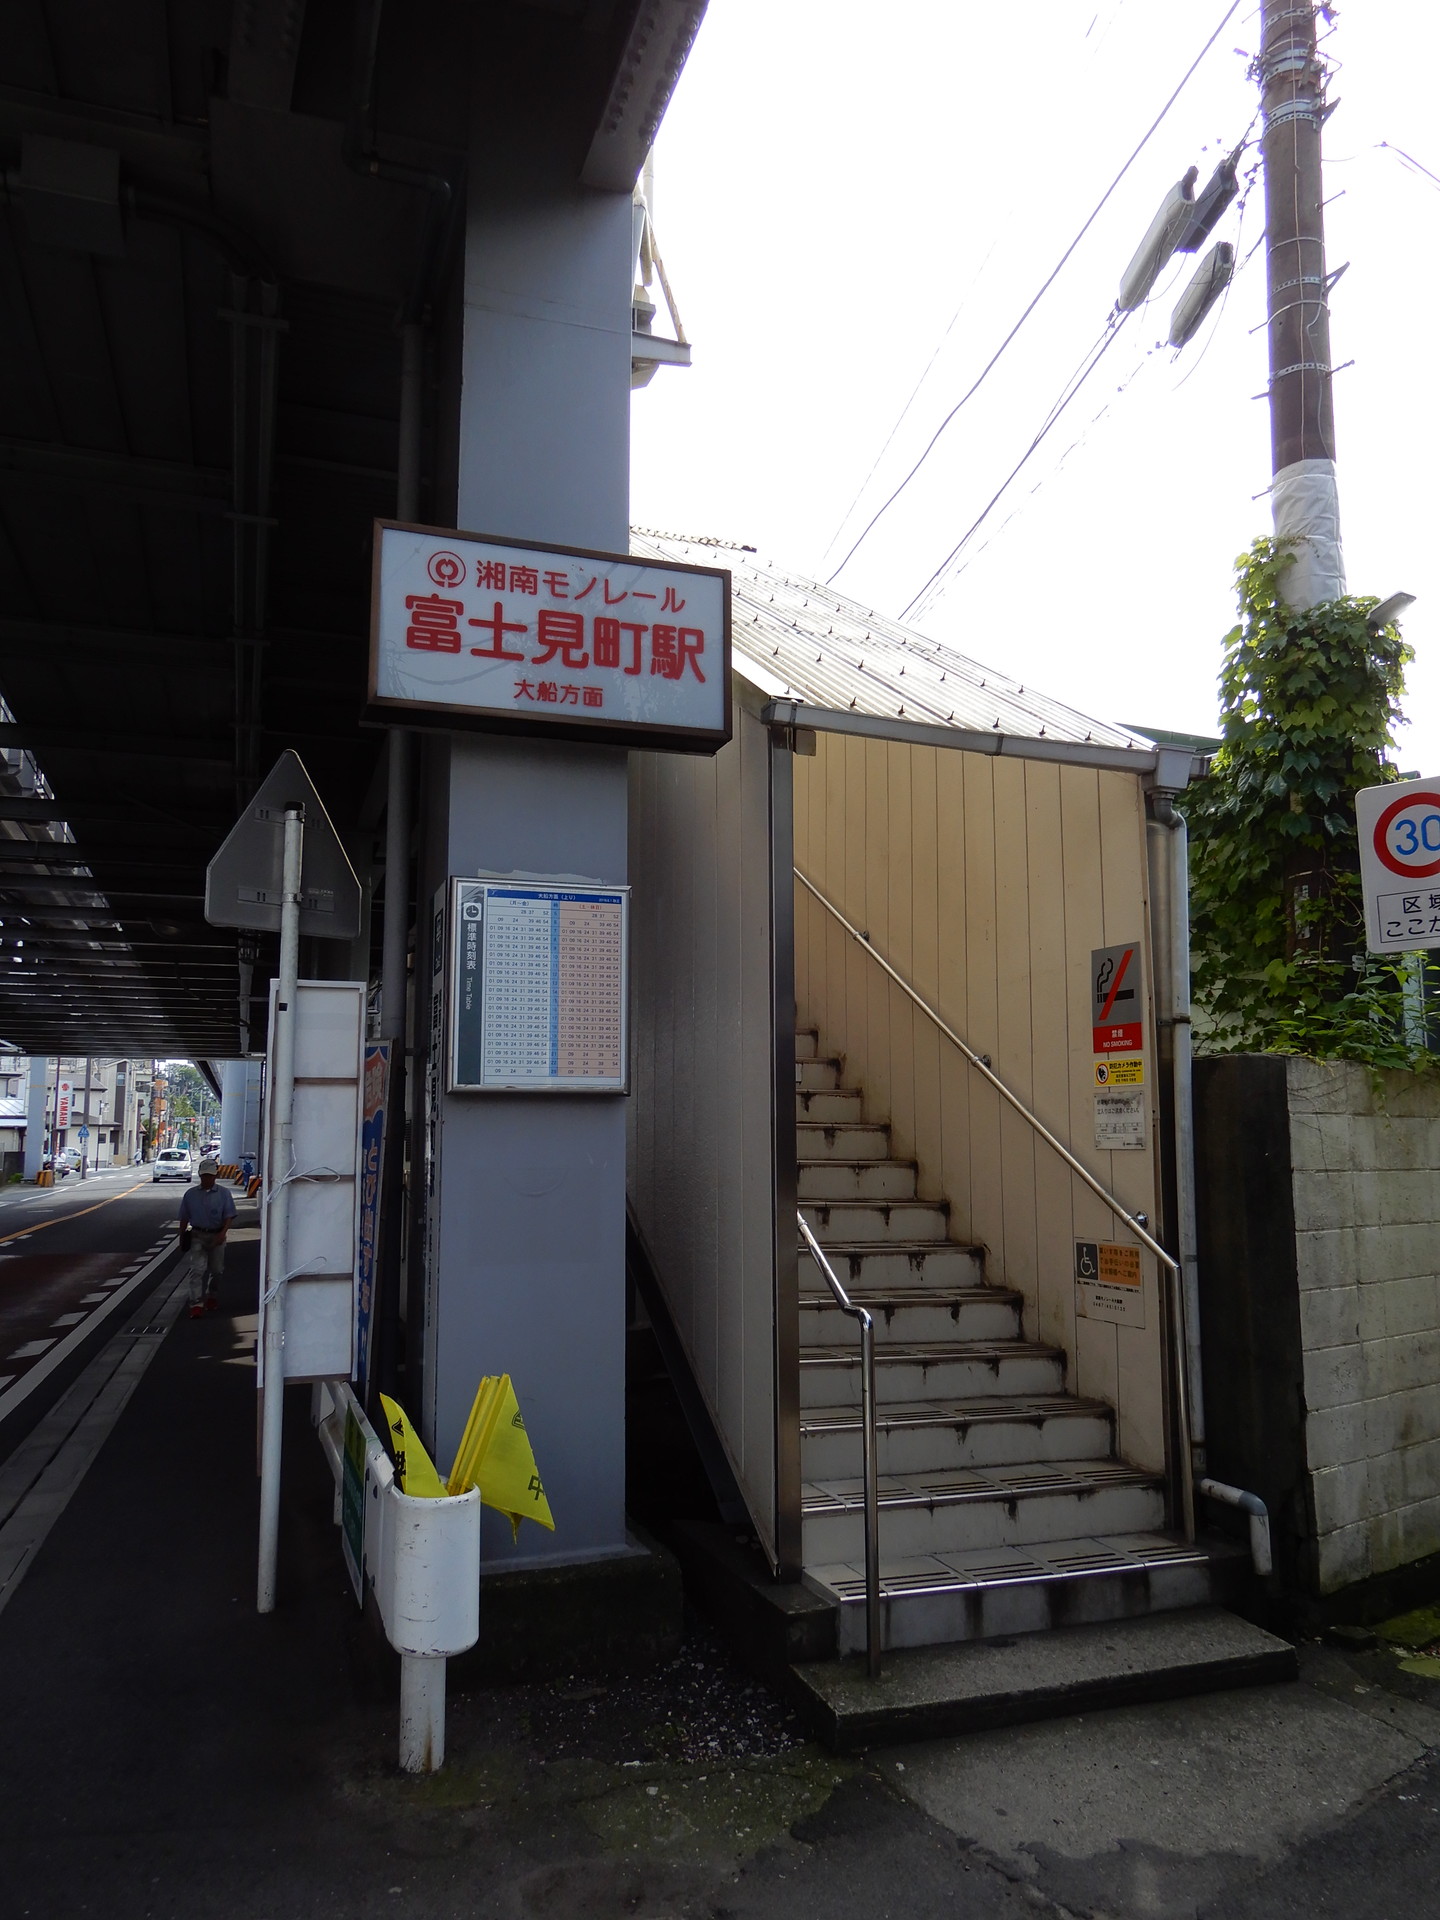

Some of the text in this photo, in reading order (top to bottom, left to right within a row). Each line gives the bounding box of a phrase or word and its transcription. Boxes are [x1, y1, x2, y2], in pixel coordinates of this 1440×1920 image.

[476, 559, 686, 614] 湘南モノレール
[405, 592, 706, 684] 富士見町駅
[513, 678, 604, 708] 大船方面
[1395, 814, 1440, 856] 30
[466, 922, 477, 970] 標準時刻表
[1110, 1039, 1133, 1048] SMOKING
[58, 1096, 70, 1127] YAMAHA
